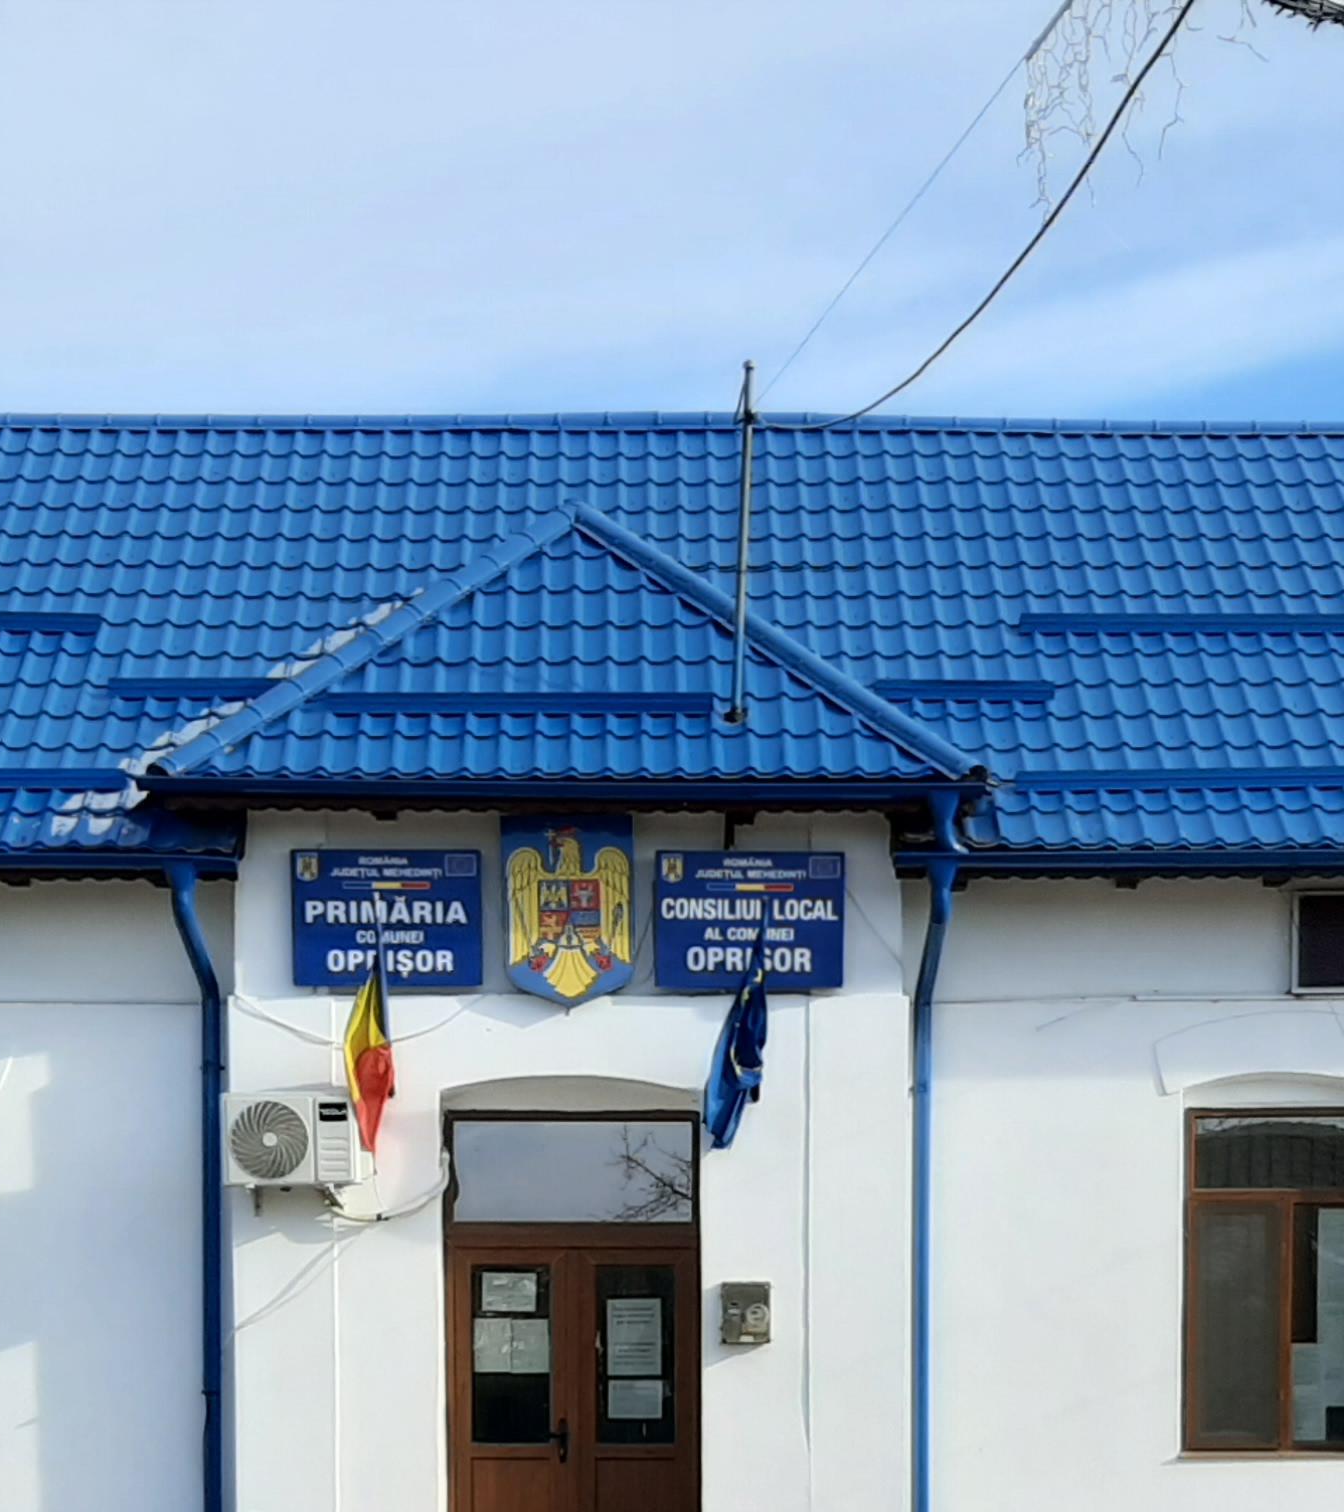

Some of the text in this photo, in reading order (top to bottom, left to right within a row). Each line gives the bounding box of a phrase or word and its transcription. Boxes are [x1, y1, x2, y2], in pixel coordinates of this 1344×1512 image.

[304, 896, 468, 924] PRIMĂRIA
[773, 899, 838, 921] LOCAL
[704, 927, 723, 941] AL
